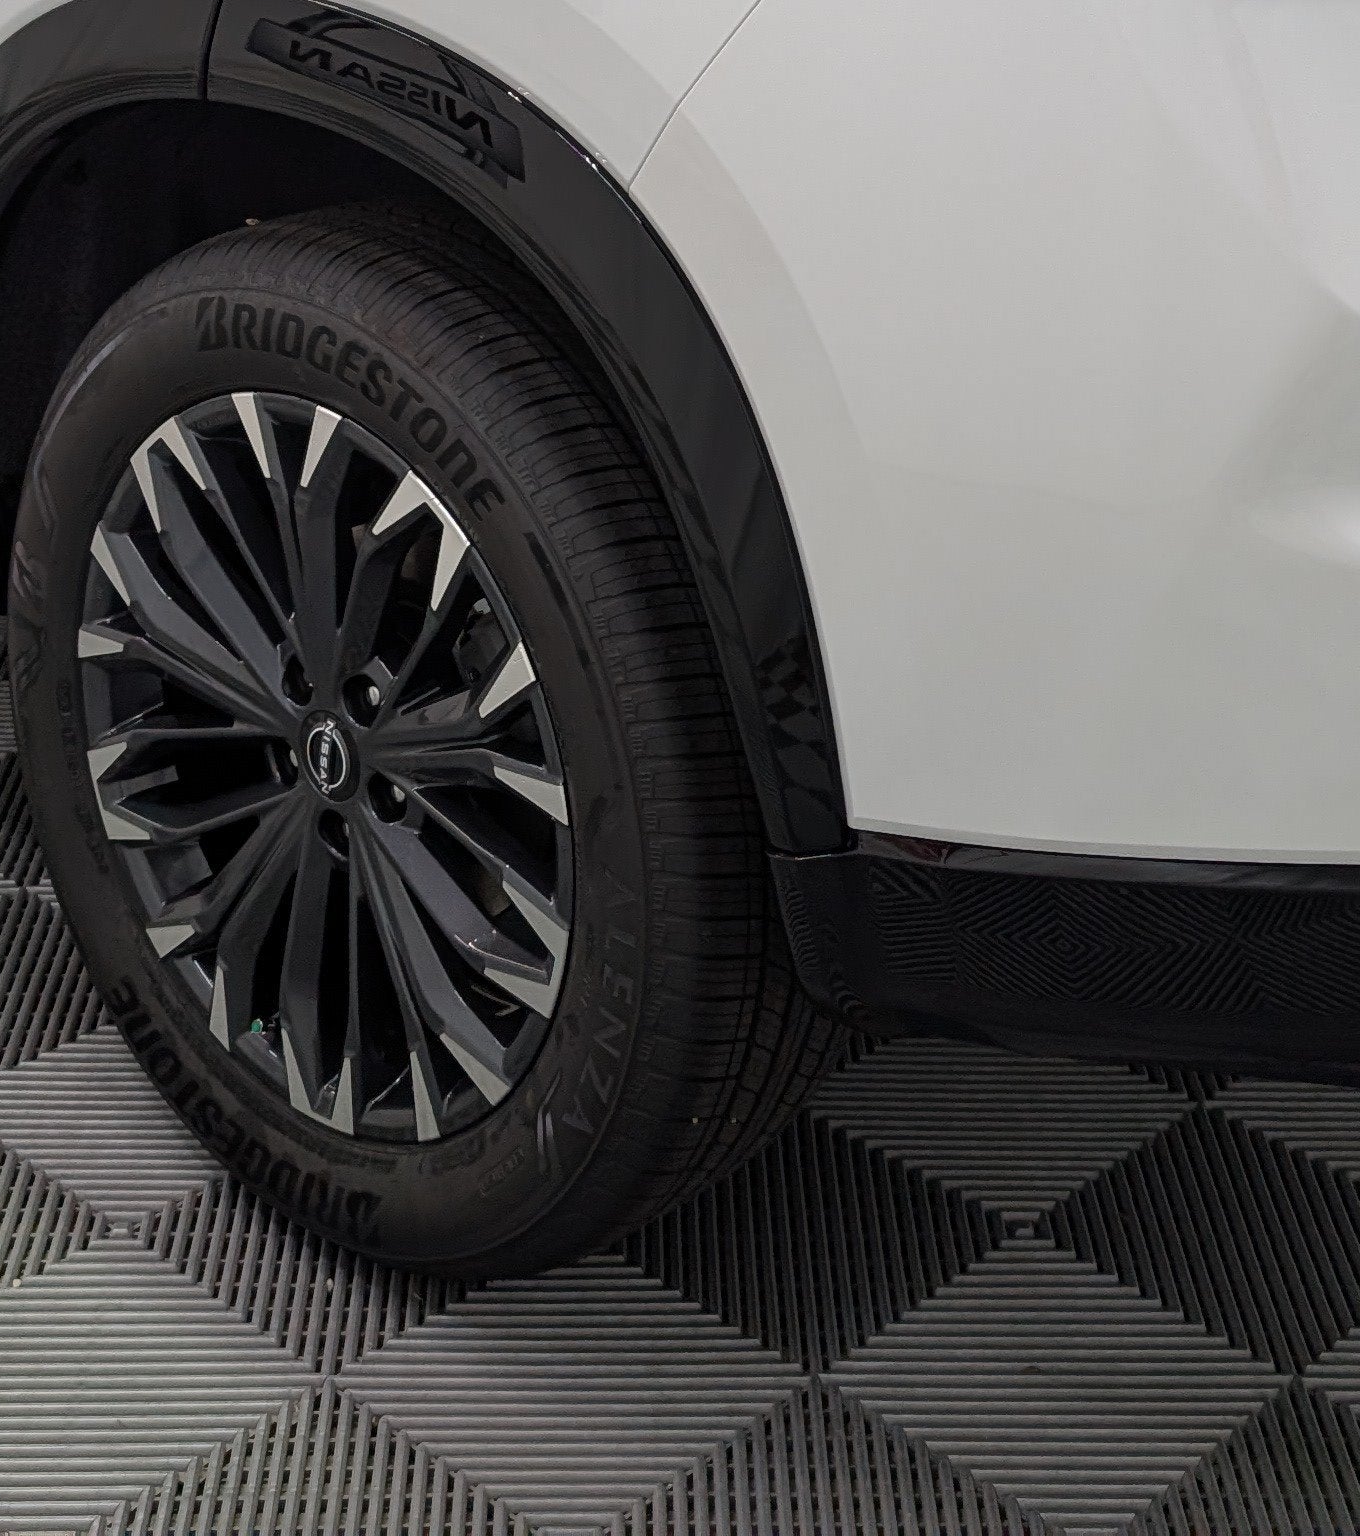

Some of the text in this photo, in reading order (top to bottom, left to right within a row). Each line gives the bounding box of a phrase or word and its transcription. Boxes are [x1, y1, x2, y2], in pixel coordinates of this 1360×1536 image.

[195, 295, 506, 522] BRIDGESTONE
[320, 718, 336, 795] NISSAN
[107, 975, 382, 1247] BRIDGESTONE
